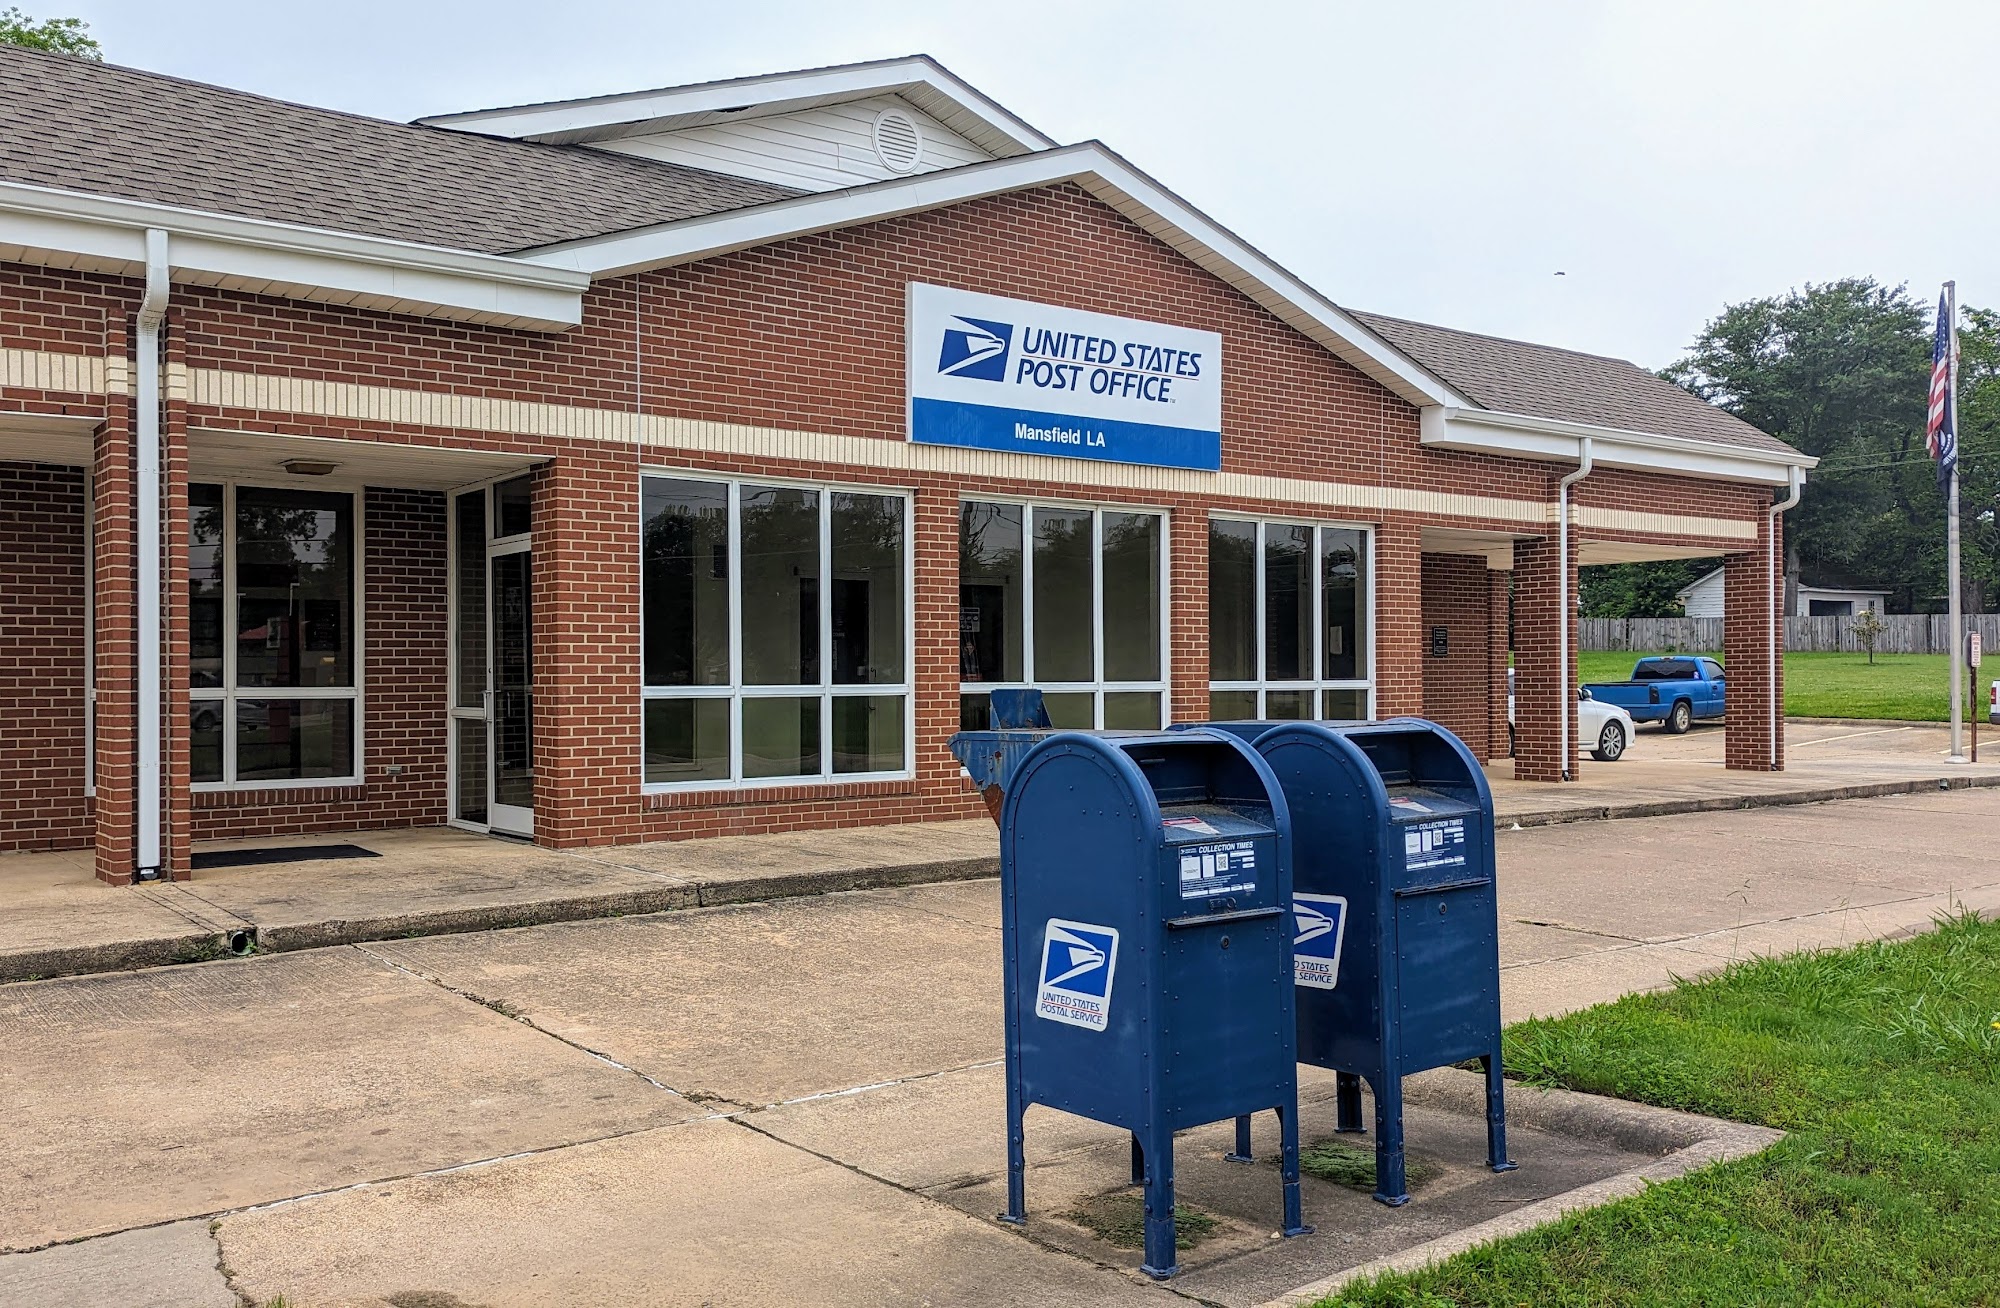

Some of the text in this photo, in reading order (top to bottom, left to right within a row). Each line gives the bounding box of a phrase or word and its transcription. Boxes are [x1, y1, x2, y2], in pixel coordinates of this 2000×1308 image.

[1022, 326, 1202, 377] UNITED STATES
[1016, 358, 1172, 403] POST OFFICE
[1014, 422, 1106, 447] Mansfield LA
[1419, 821, 1448, 830] COLLECTION
[1198, 843, 1236, 854] COLLECTION
[1236, 841, 1254, 850] TIMES
[1300, 961, 1330, 972] STATES
[1298, 971, 1333, 984] SERVICE
[1042, 991, 1100, 1011] UNITED STATES
[1041, 1003, 1103, 1024] POSTAL SERVICE
